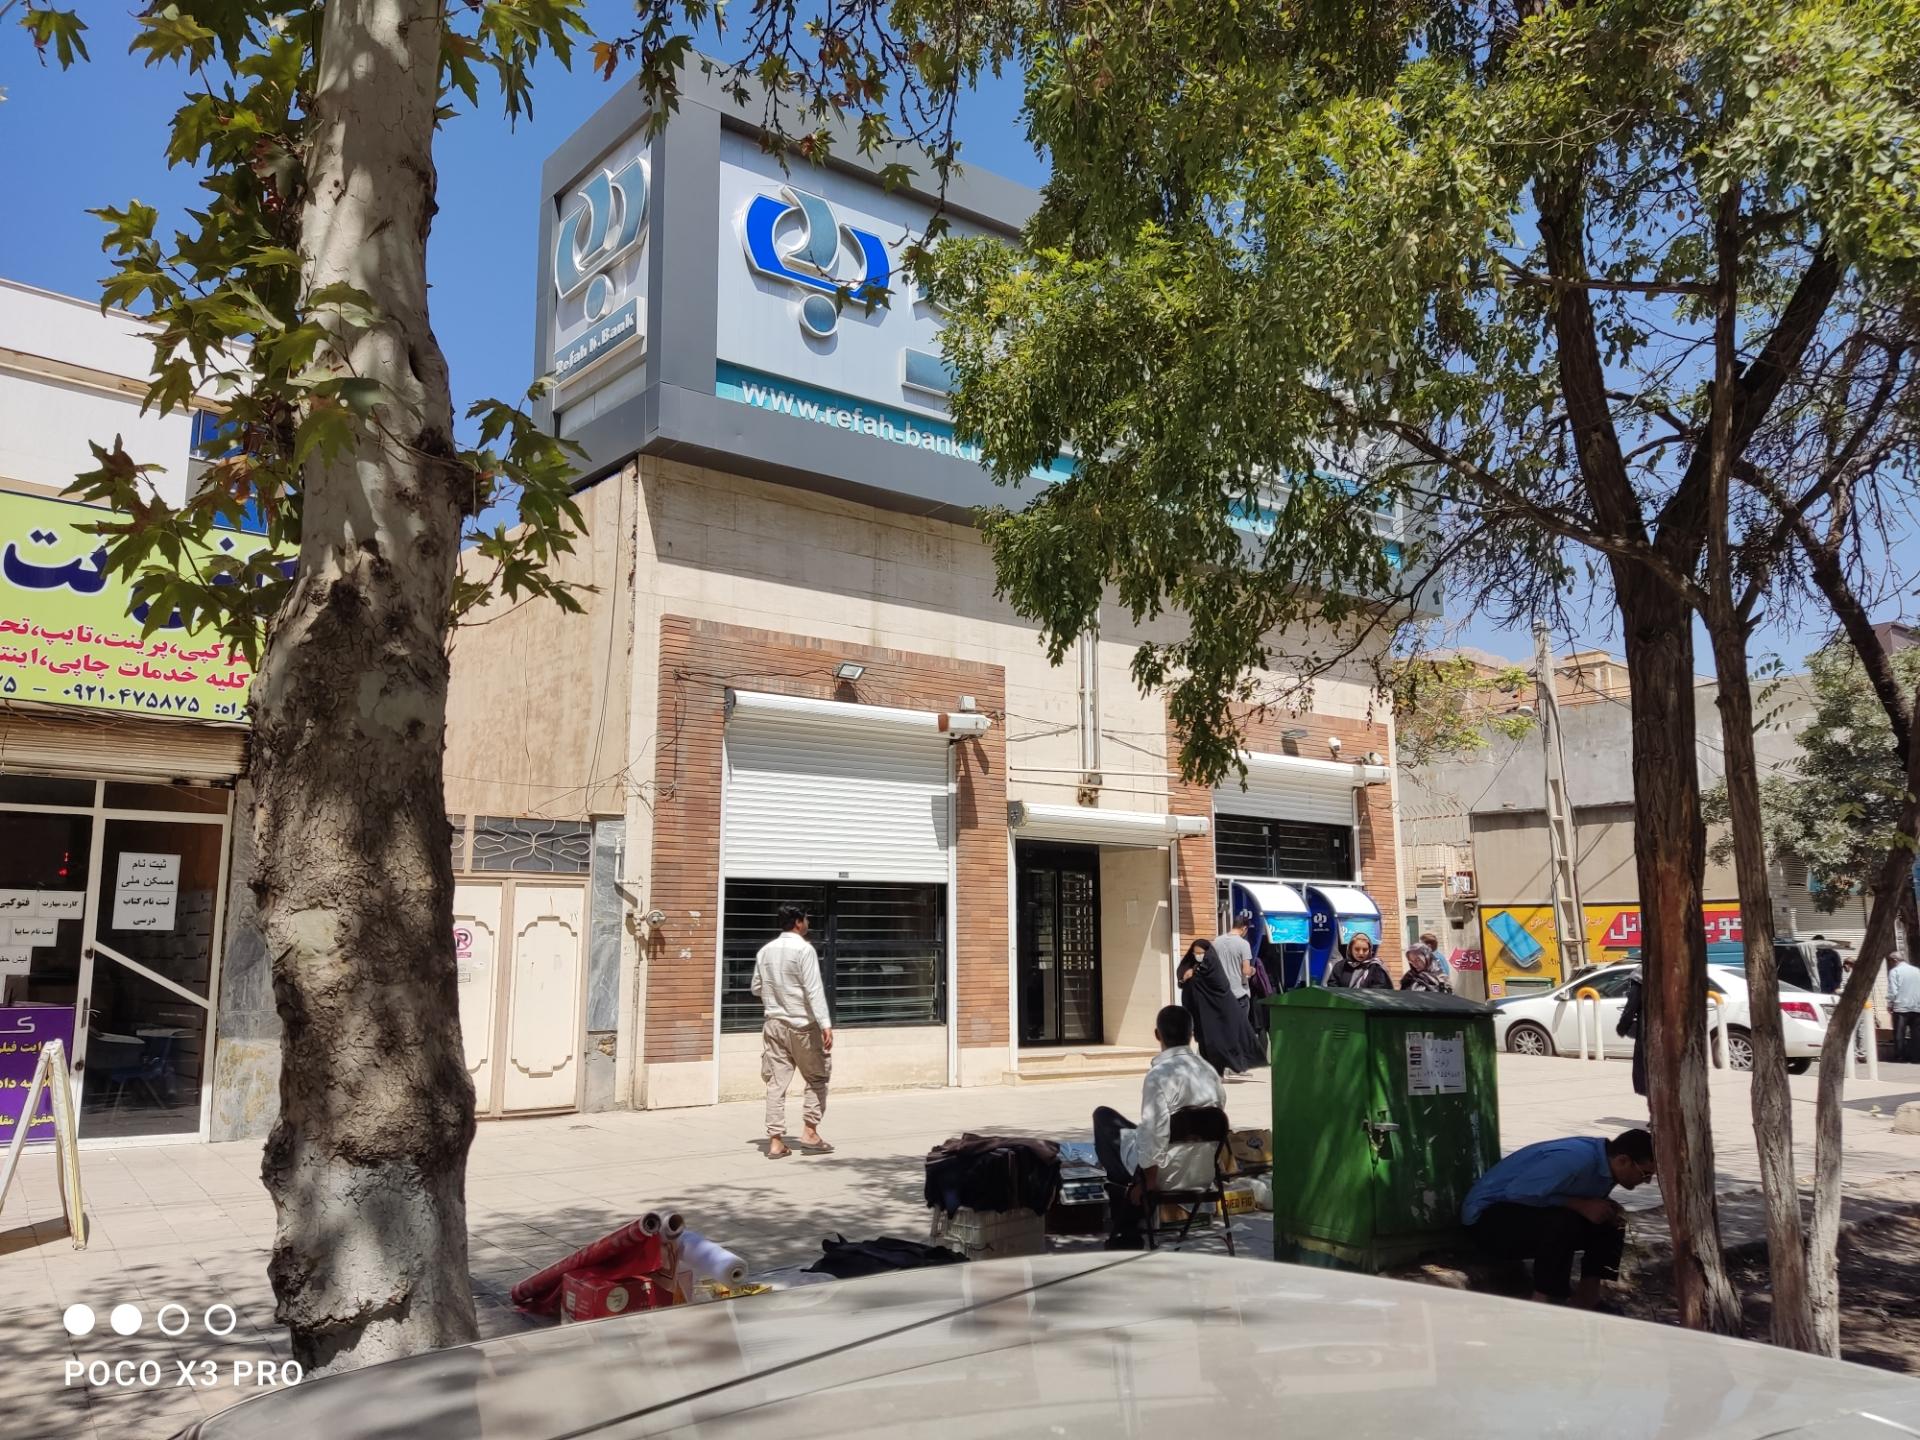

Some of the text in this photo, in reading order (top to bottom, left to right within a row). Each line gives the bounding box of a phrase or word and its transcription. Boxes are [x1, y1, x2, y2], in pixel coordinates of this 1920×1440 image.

[556, 345, 588, 375] Refah
[118, 661, 199, 682] خدمات
[206, 671, 250, 692] کلیه
[132, 859, 167, 870] ثبت نام
[121, 875, 174, 888] مسکن ملی
